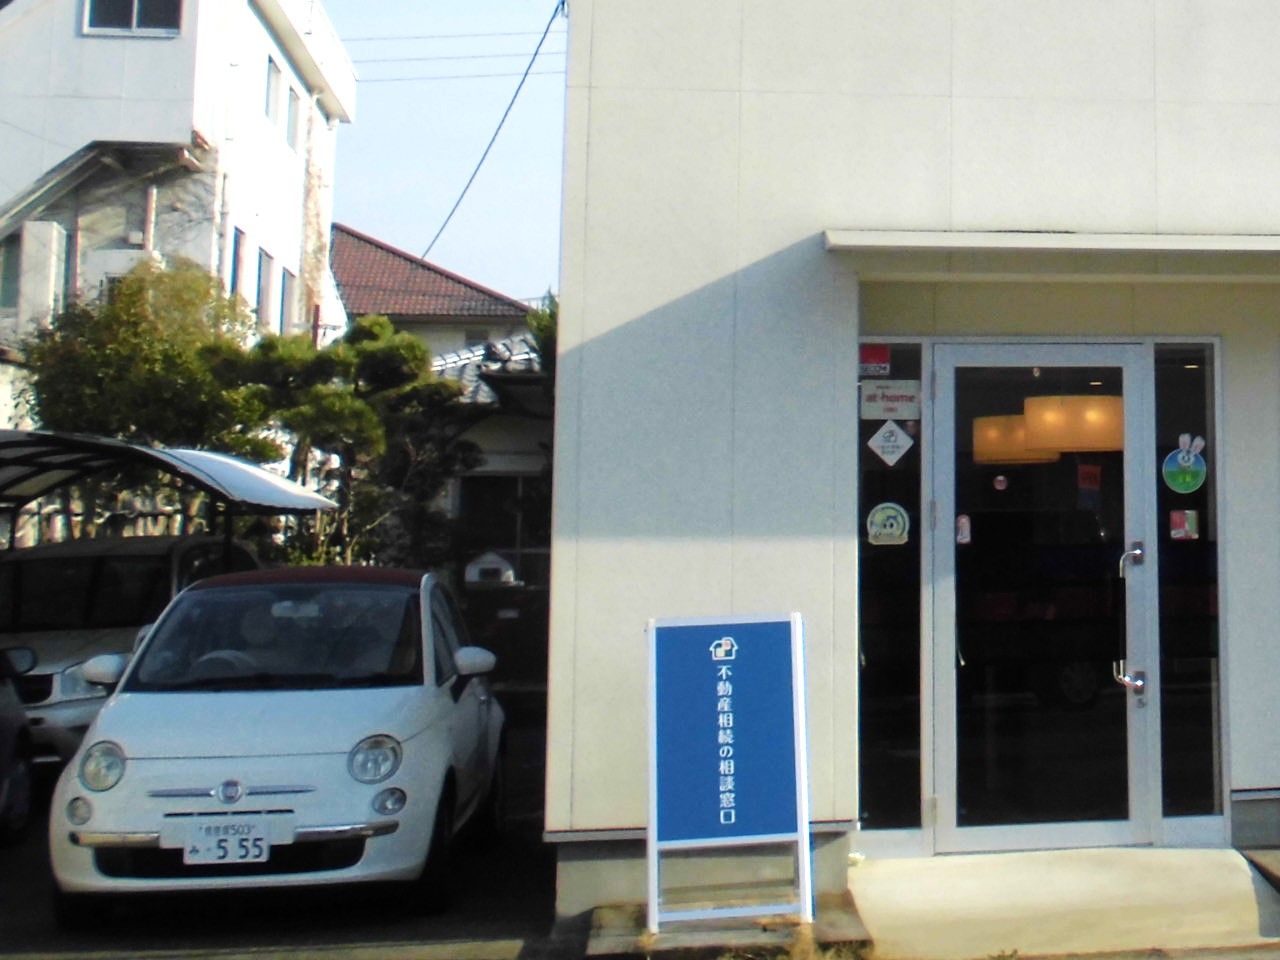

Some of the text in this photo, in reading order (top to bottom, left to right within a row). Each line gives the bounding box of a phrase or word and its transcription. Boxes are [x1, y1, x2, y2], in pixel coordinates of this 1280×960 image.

[715, 664, 736, 825] 不動産相続の相談窓口
